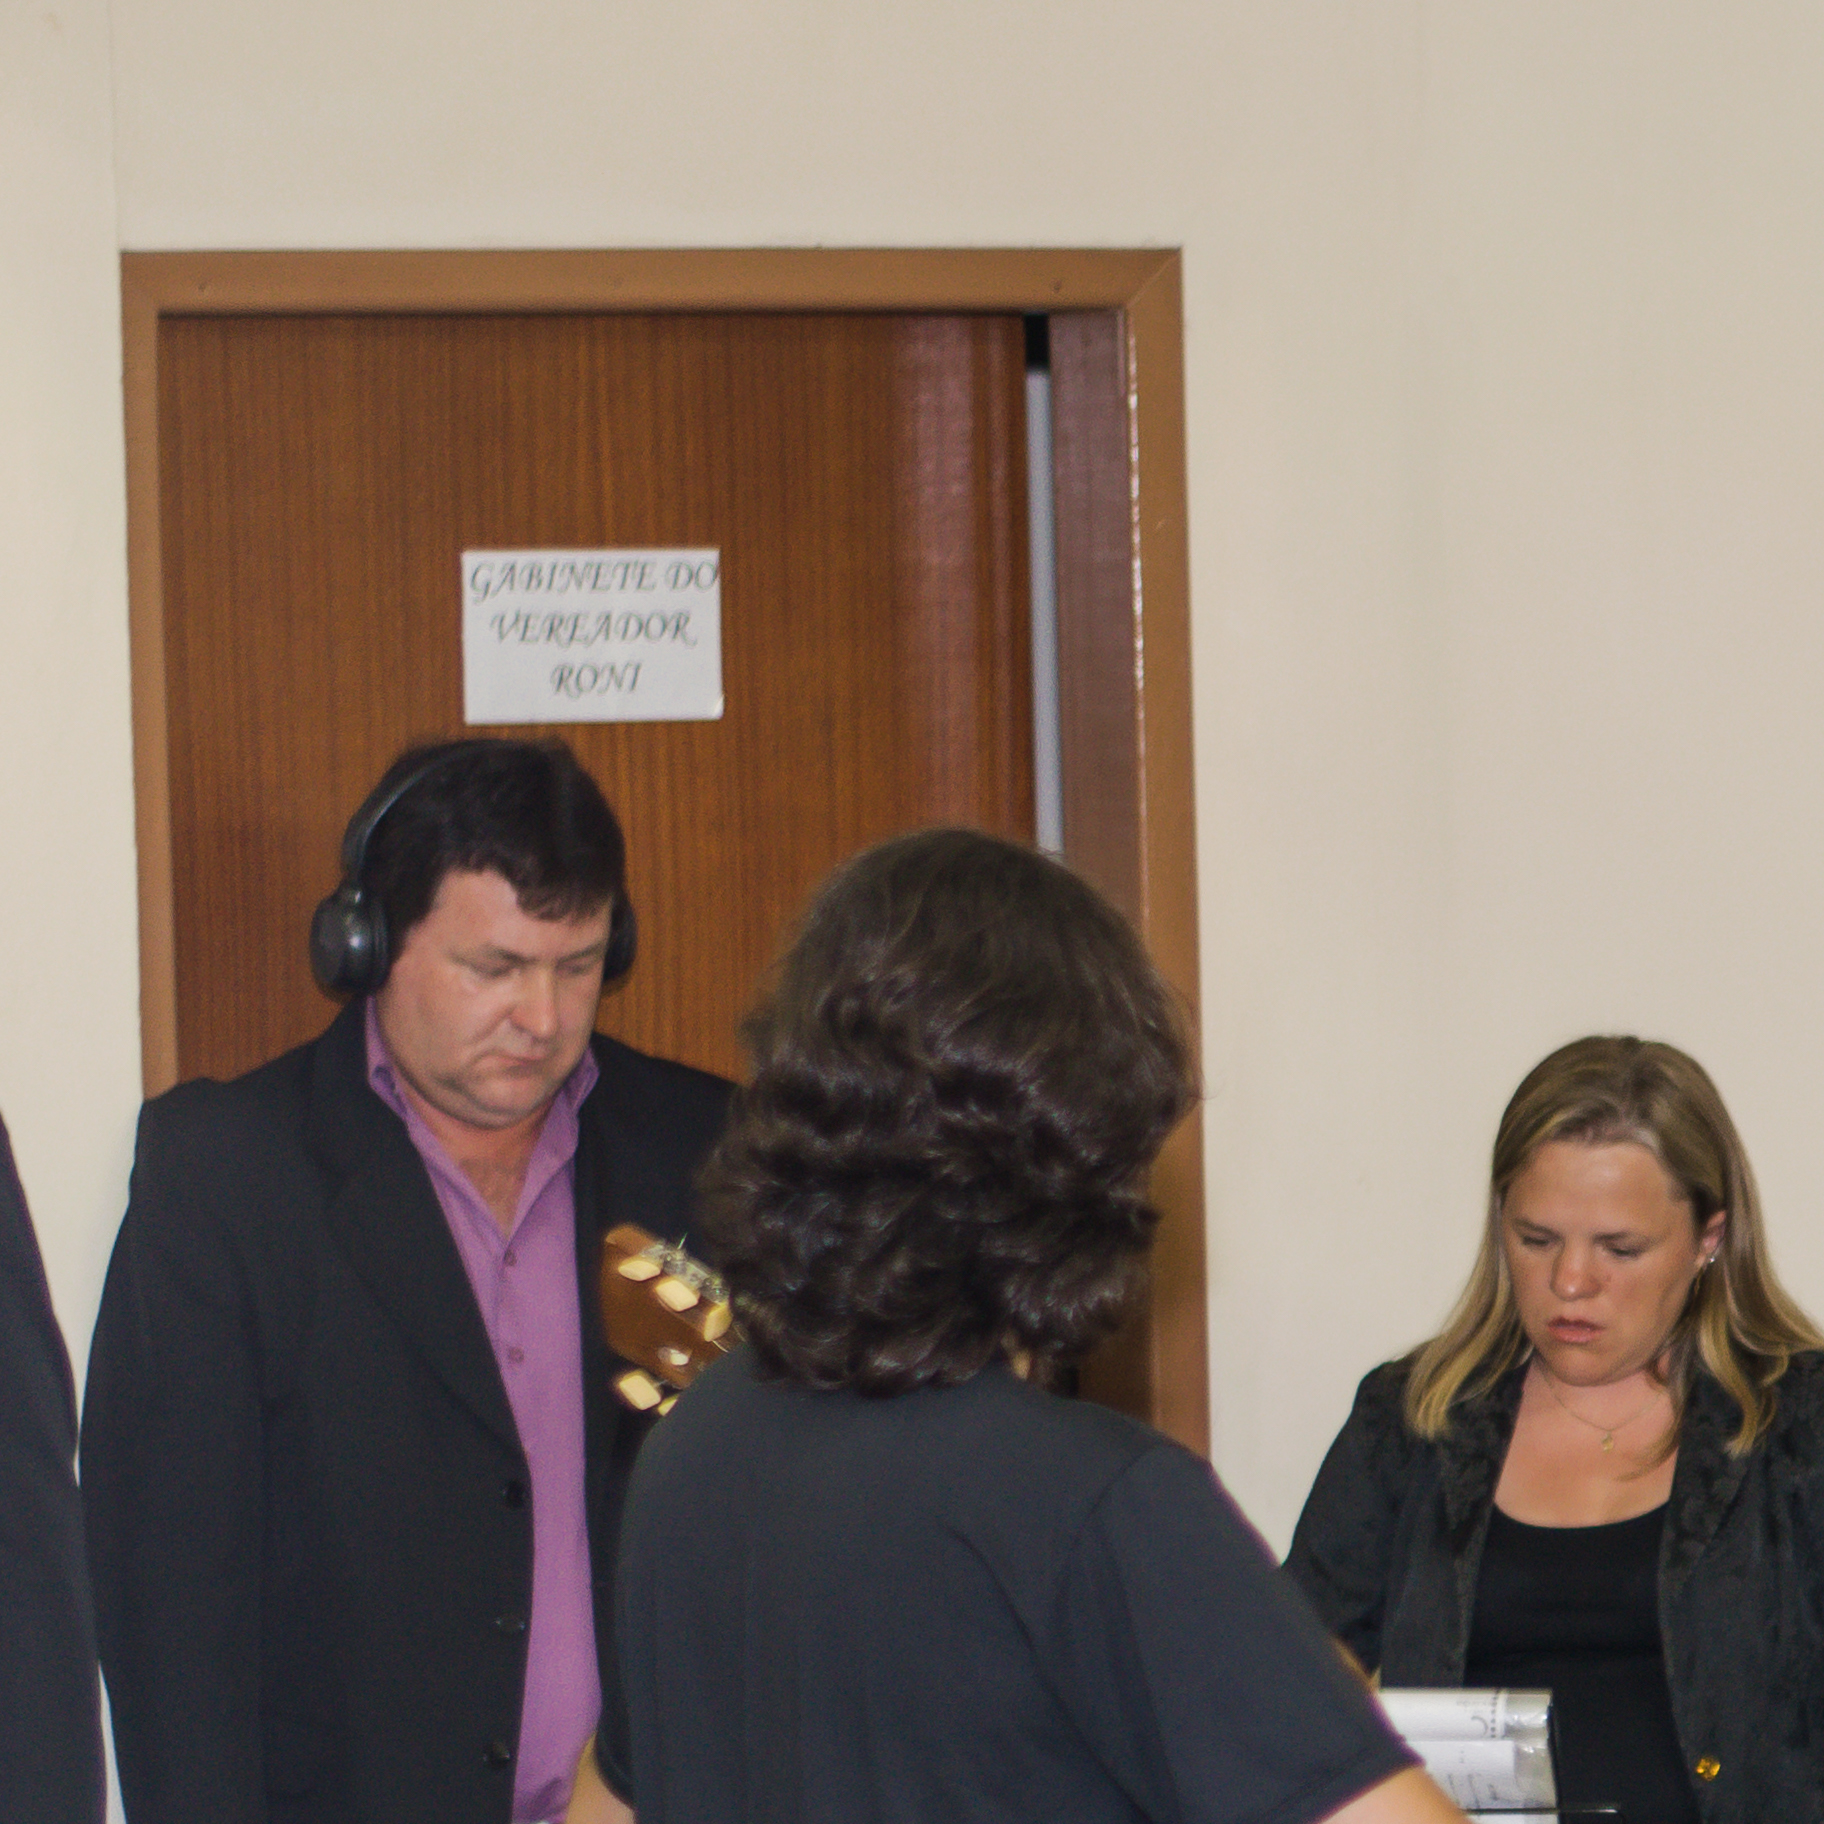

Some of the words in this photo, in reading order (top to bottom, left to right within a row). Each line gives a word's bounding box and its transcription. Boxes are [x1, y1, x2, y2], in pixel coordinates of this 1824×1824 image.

[470, 560, 656, 604] GABINETE
[666, 560, 718, 592] DO
[490, 608, 698, 648] VEREADOR
[552, 660, 643, 699] RONI
